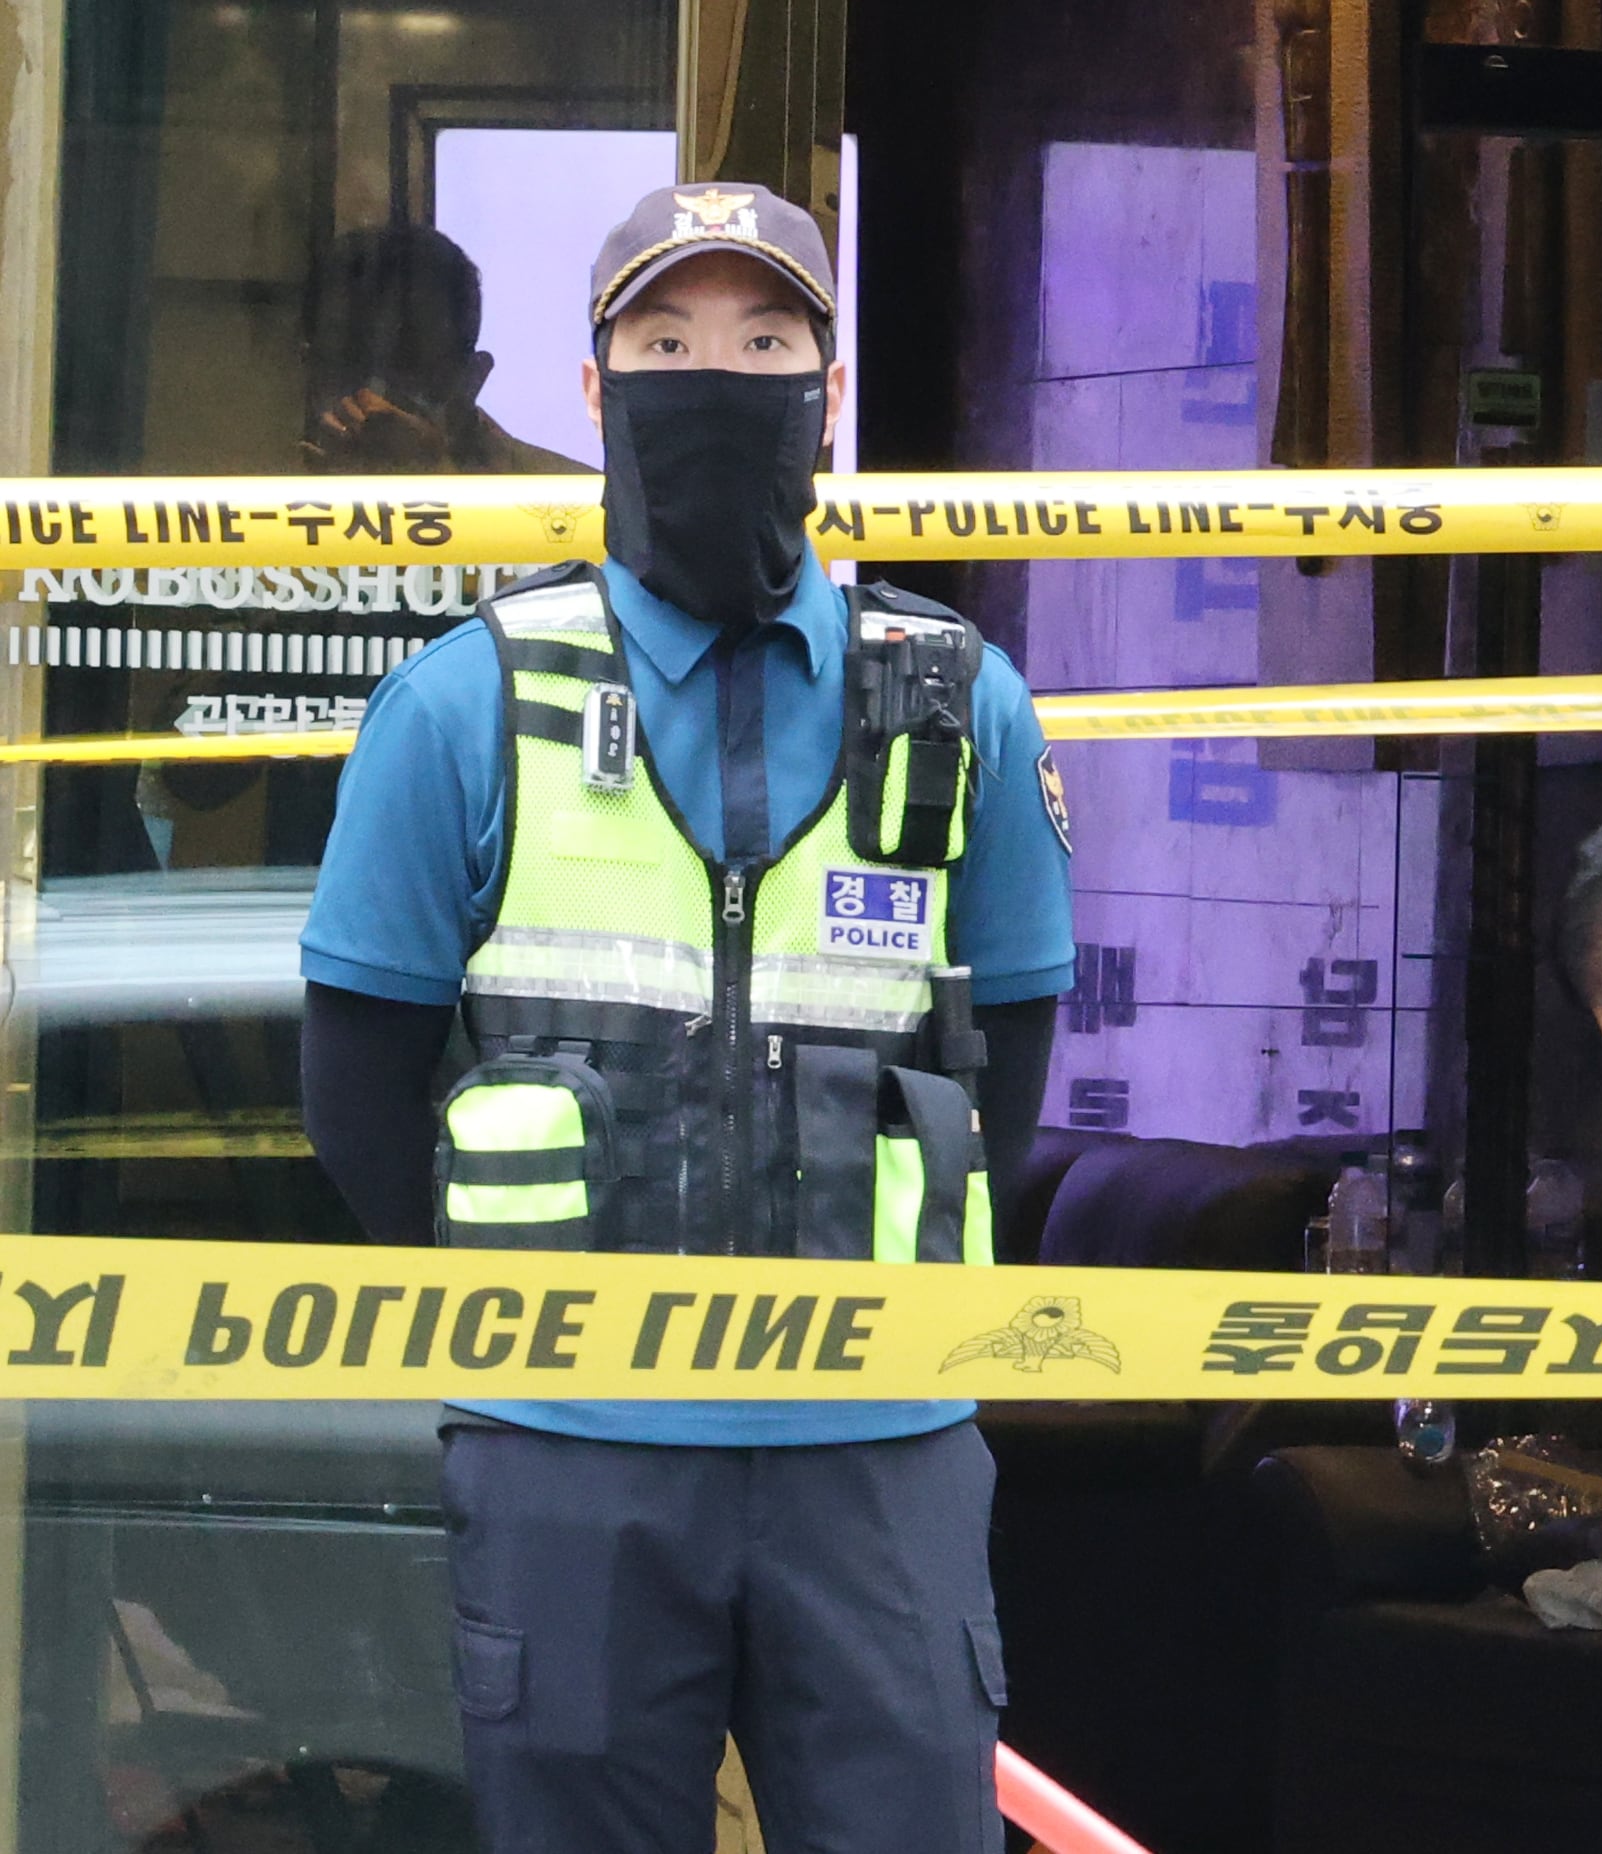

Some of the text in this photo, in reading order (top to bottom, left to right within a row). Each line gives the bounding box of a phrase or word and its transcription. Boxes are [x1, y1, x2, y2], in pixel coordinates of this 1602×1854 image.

[5, 499, 98, 545] ICE
[831, 875, 922, 922] 경찰
[830, 926, 919, 950] POLICE
